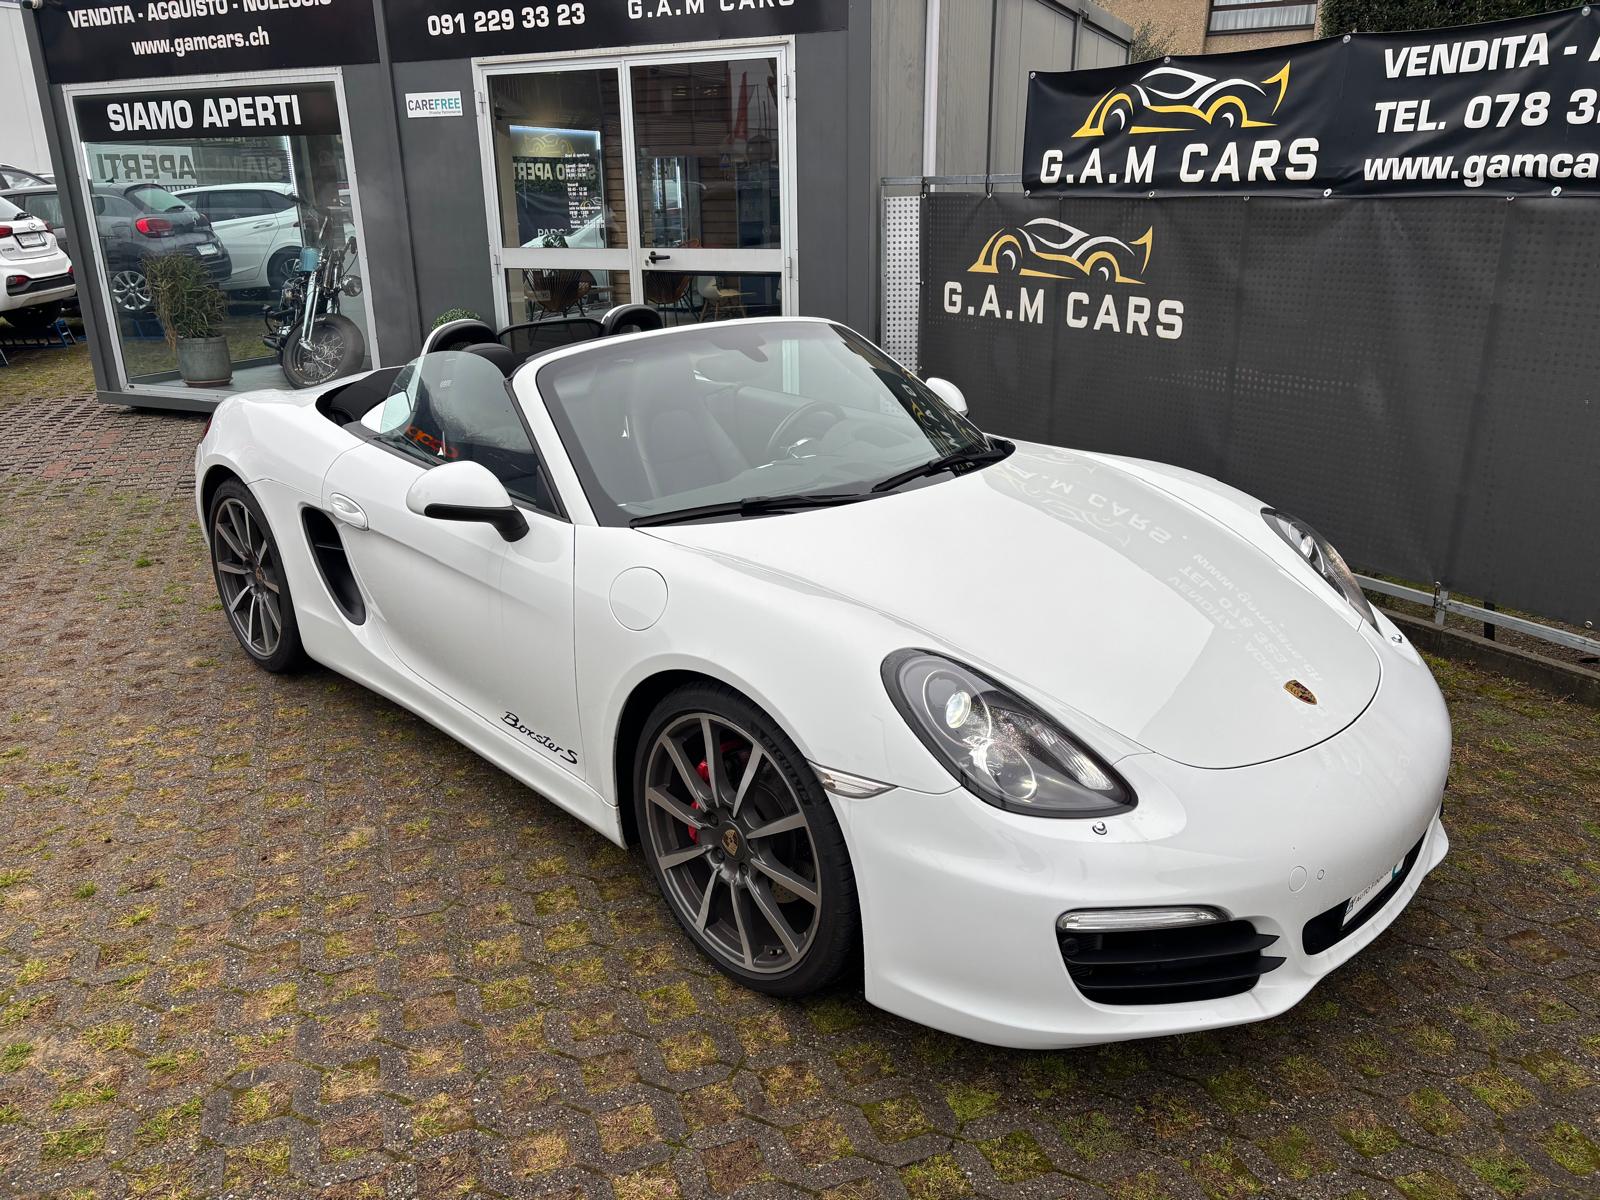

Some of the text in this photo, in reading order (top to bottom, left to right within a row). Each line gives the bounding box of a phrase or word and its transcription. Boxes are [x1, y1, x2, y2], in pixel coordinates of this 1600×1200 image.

[68, 5, 135, 28] VENDITA
[147, 0, 228, 22] ACQUISTO
[243, 0, 332, 12] NOLE
[427, 2, 586, 37] 091 229 33 23
[132, 25, 270, 57] www.gamcars.ch
[1384, 32, 1549, 78] VENDITA
[106, 94, 302, 132] SIAMO APERTI
[408, 97, 461, 111] CAREFREE
[1374, 88, 1600, 133] TEL. 078 3
[1039, 137, 1320, 184] G.A.M CARS
[1363, 152, 1600, 188] www.gamca
[943, 280, 1185, 340] G.A.M CARS
[501, 711, 578, 765] Boxster S
